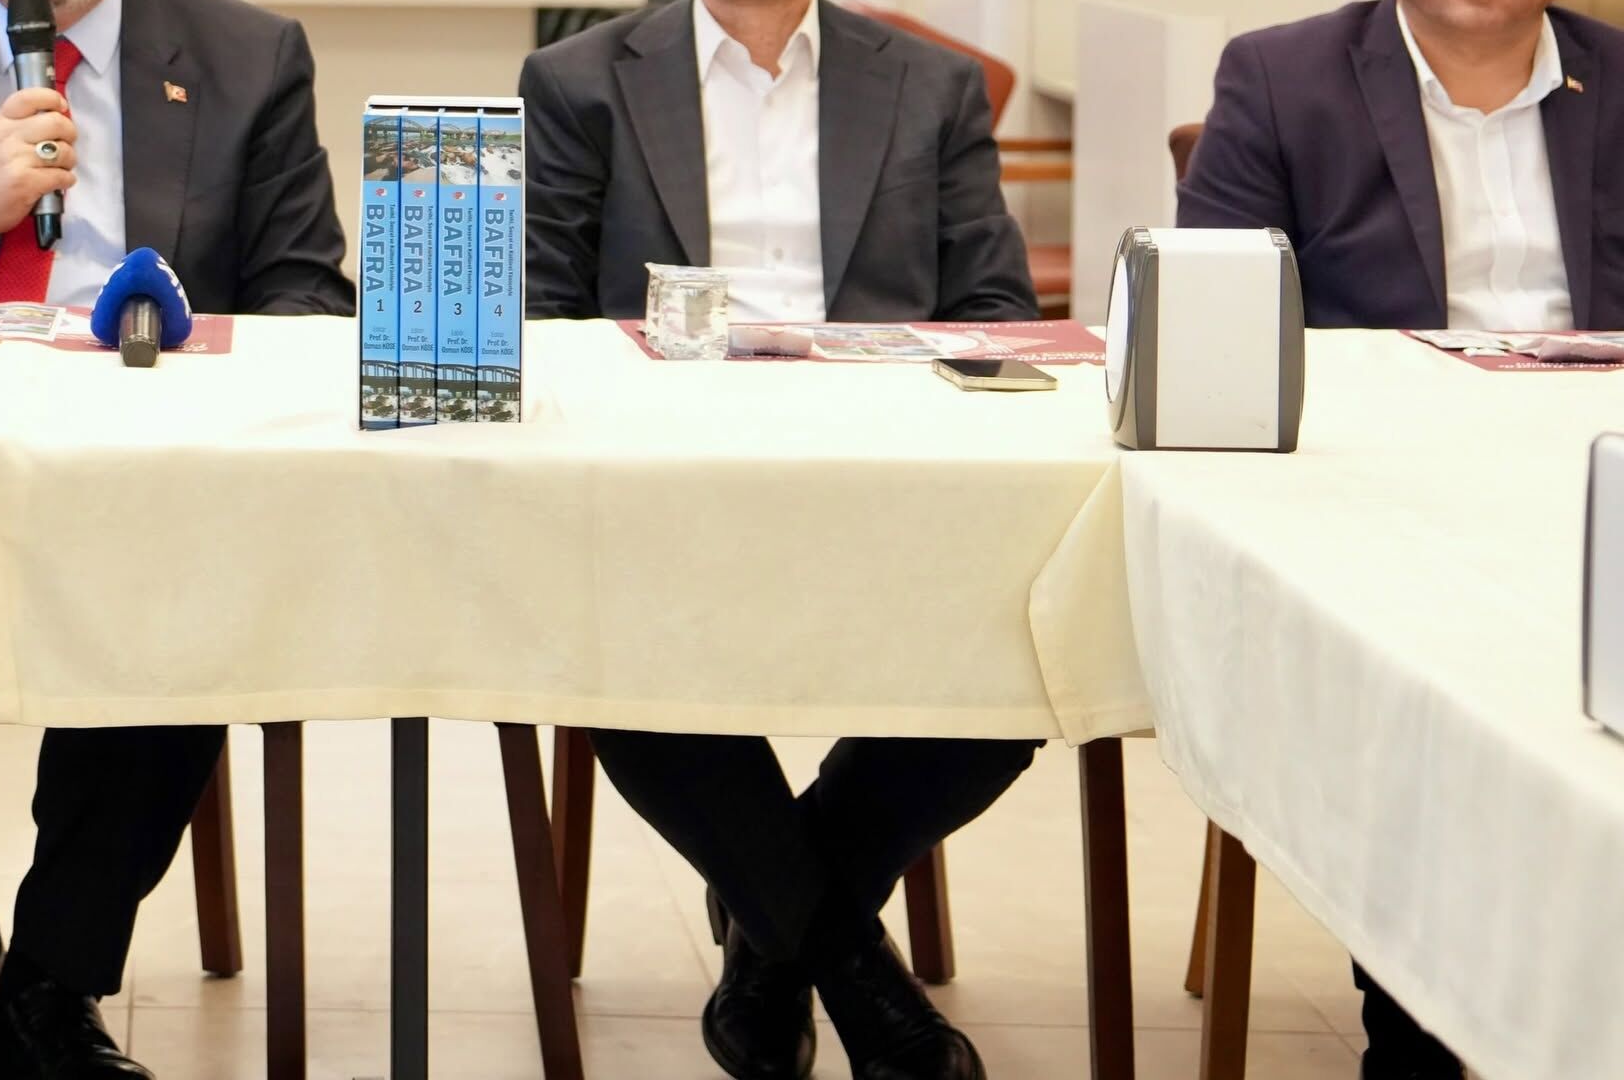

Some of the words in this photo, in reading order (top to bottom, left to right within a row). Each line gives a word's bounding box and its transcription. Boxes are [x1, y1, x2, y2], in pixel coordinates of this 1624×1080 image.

[366, 204, 385, 292] BAFRA
[404, 206, 423, 294] BAFRA
[444, 208, 463, 296] BAFRA
[484, 209, 504, 297] BAFRA
[377, 299, 384, 311] 1
[413, 300, 422, 313] 2
[454, 303, 462, 315] 3
[494, 304, 502, 317] 4
